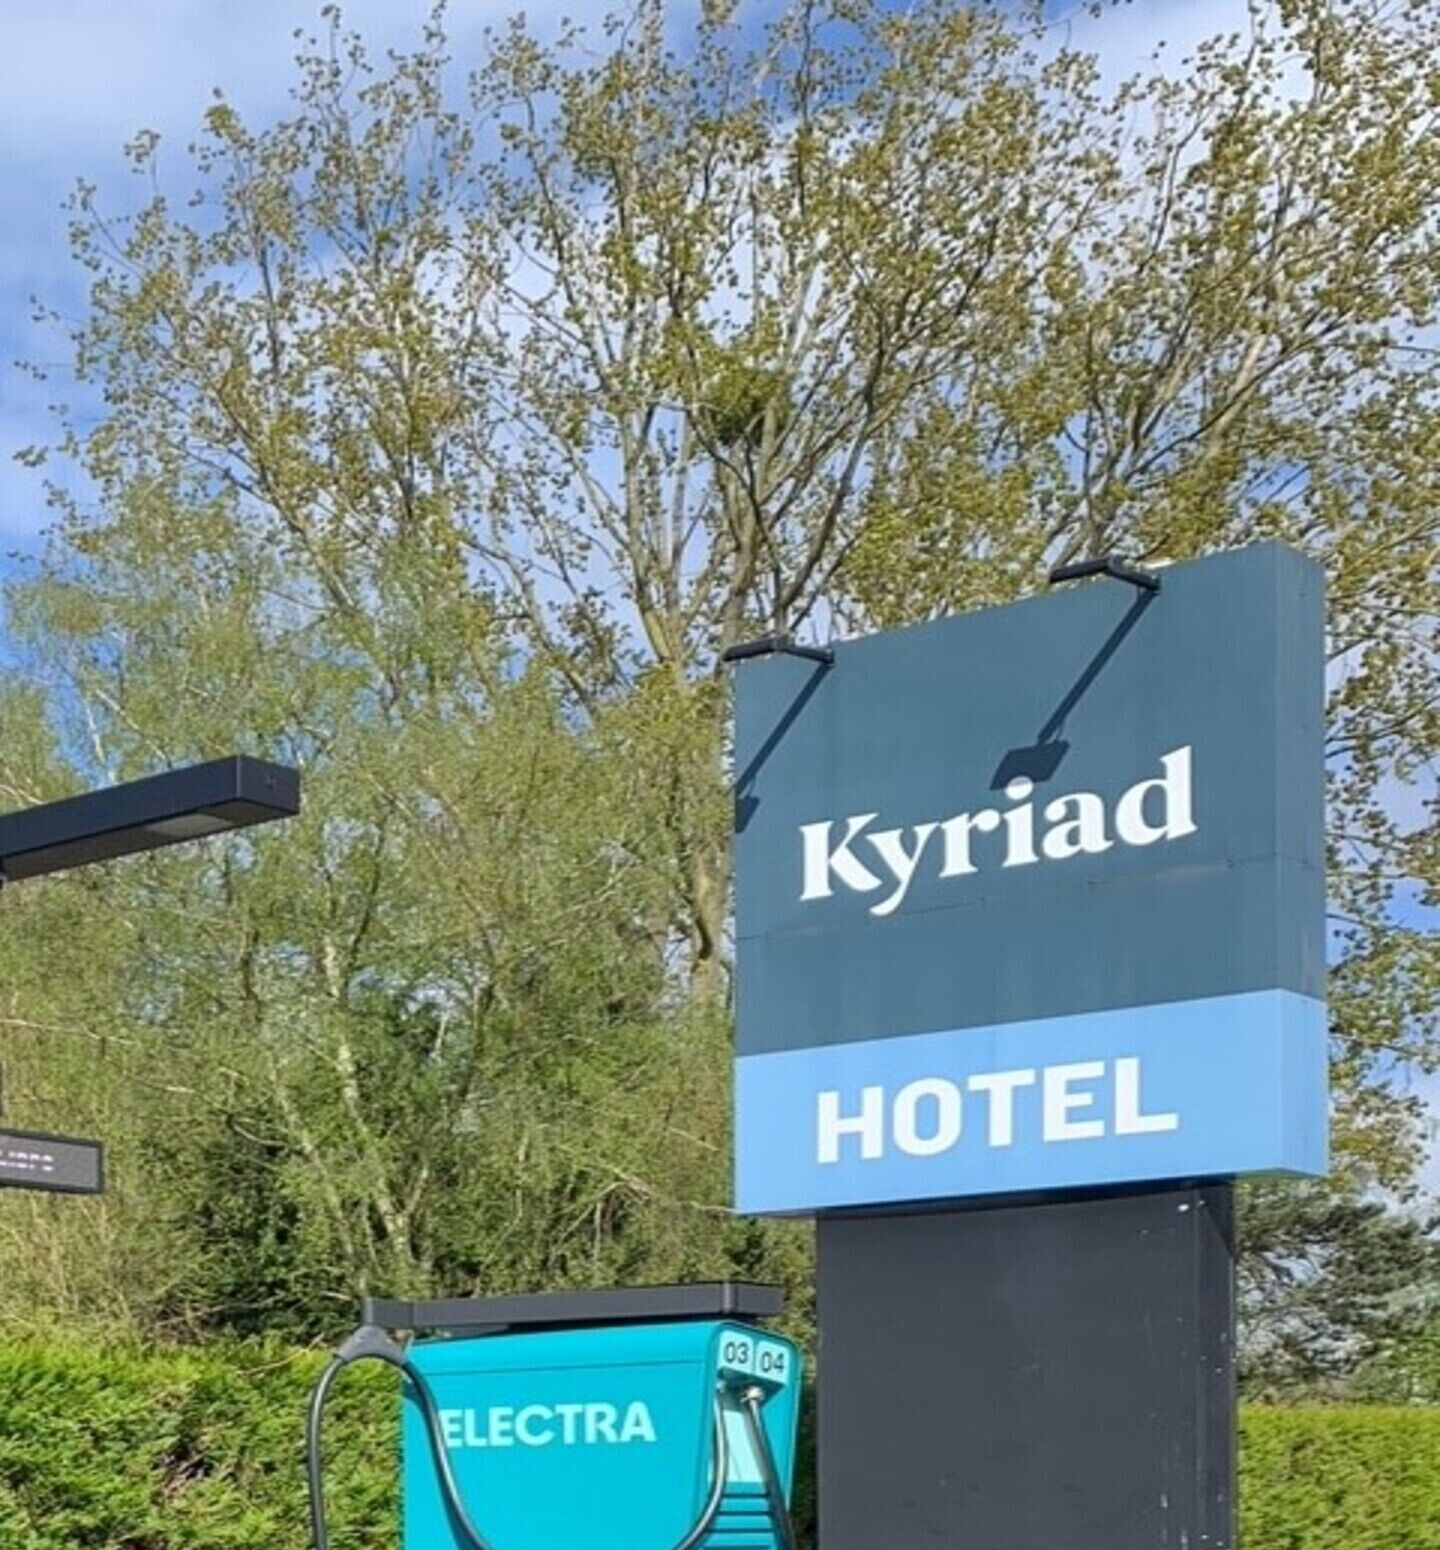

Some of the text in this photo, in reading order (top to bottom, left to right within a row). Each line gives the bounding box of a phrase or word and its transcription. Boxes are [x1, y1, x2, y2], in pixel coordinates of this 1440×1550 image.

[799, 745, 1198, 916] Kyriad
[816, 1056, 1178, 1165] HOTEL
[724, 1341, 785, 1374] 03 04
[438, 1400, 657, 1448] ELECTRA
